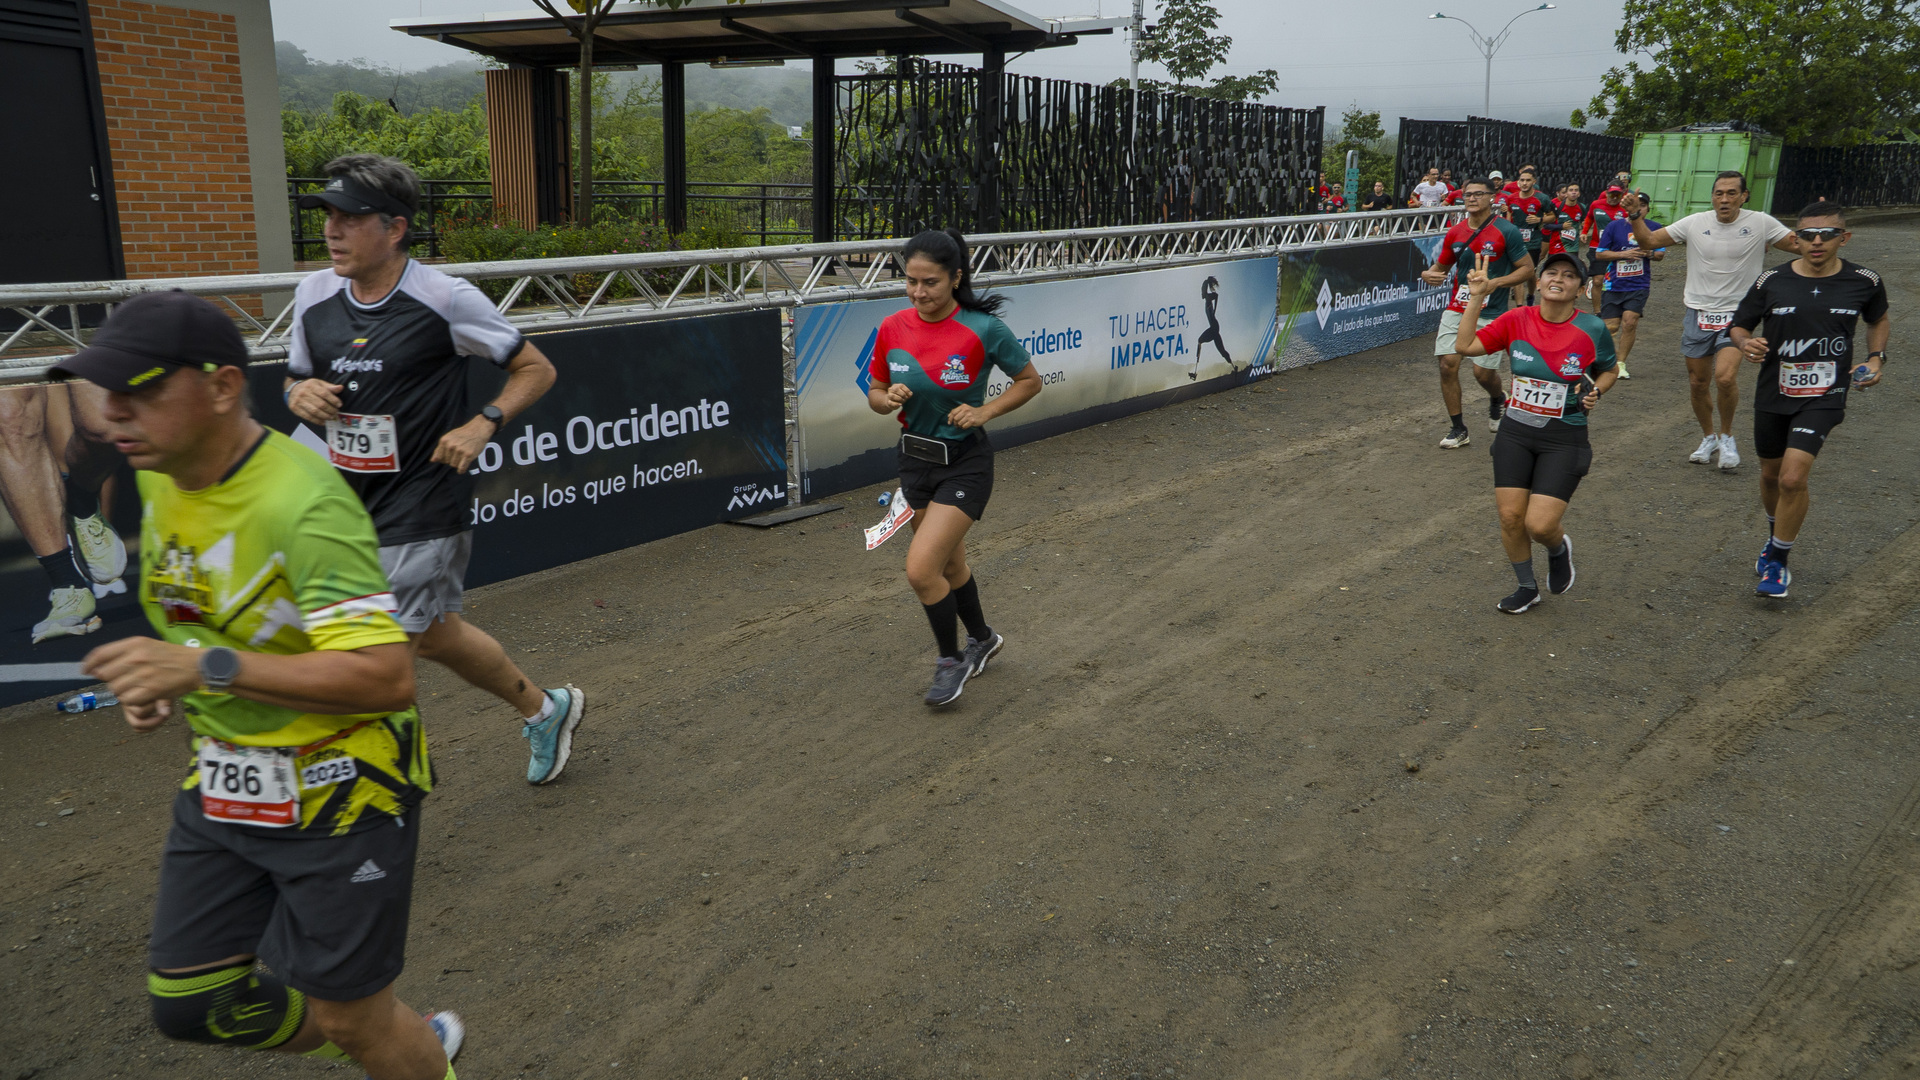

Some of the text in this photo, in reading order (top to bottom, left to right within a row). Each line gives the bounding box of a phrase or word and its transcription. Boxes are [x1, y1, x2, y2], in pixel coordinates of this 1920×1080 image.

[1623, 264, 1638, 272] 970
[1334, 284, 1409, 312] Banco de Occidente
[1109, 304, 1190, 339] TU HACER,
[1704, 314, 1728, 324] 1691
[1111, 333, 1189, 370] IMPACTA.
[1249, 364, 1271, 377] AVAL
[1789, 373, 1819, 386] 580
[1524, 389, 1551, 405] 717
[336, 431, 370, 454] 579
[512, 424, 558, 466] de
[566, 398, 730, 455] Occidente
[502, 488, 535, 517] de
[542, 482, 577, 509] los
[583, 475, 627, 505] que
[632, 458, 703, 489] hacen.
[726, 484, 785, 512] AVAL
[733, 482, 757, 494] Grupo
[205, 760, 261, 797] 786
[304, 760, 352, 785] 2025
